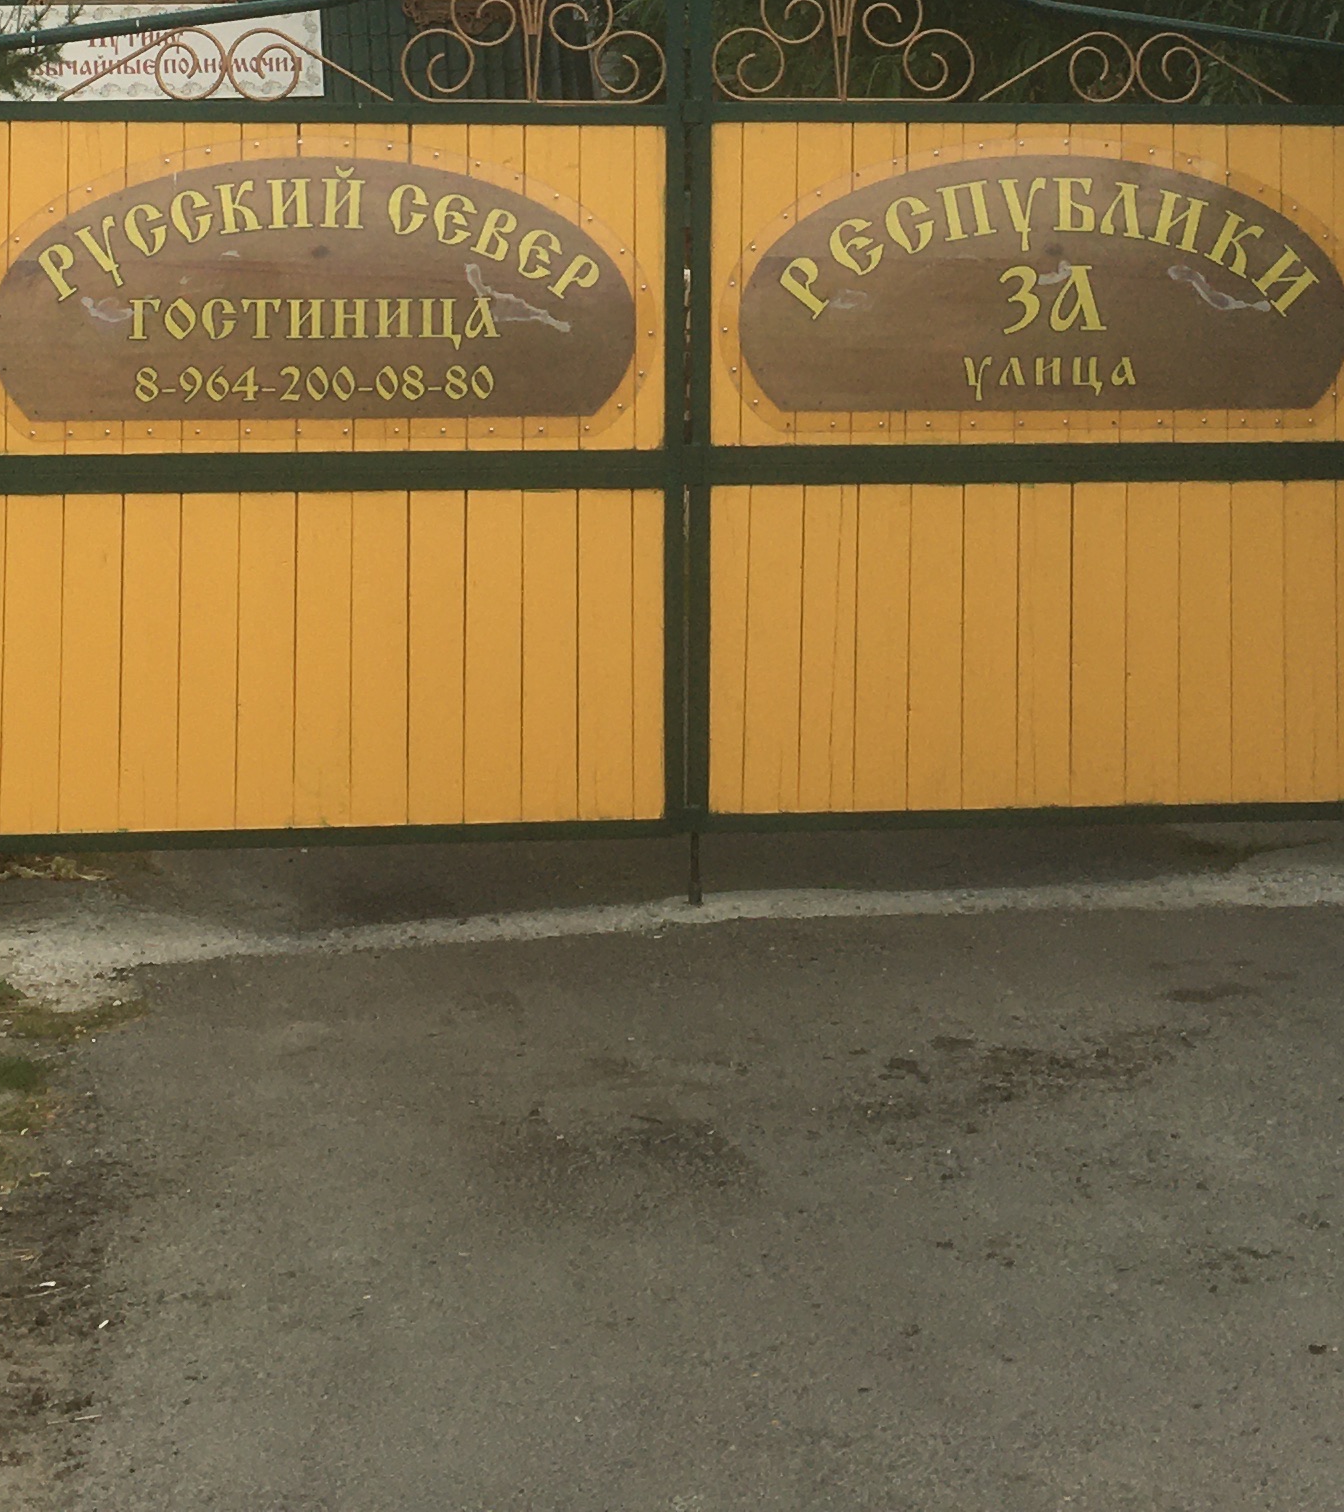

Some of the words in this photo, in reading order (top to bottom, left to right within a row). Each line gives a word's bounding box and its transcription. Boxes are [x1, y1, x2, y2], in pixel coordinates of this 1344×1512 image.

[163, 56, 303, 75] полнмочия
[35, 164, 366, 302] РУССКИЙ
[385, 182, 602, 300] СЕВЕР
[778, 173, 1321, 322] РЕСПУБЛИКИ
[127, 294, 502, 350] ГОСТИНИЦА
[132, 363, 496, 404] 8-964-200-08-80
[962, 355, 1138, 402] улица
